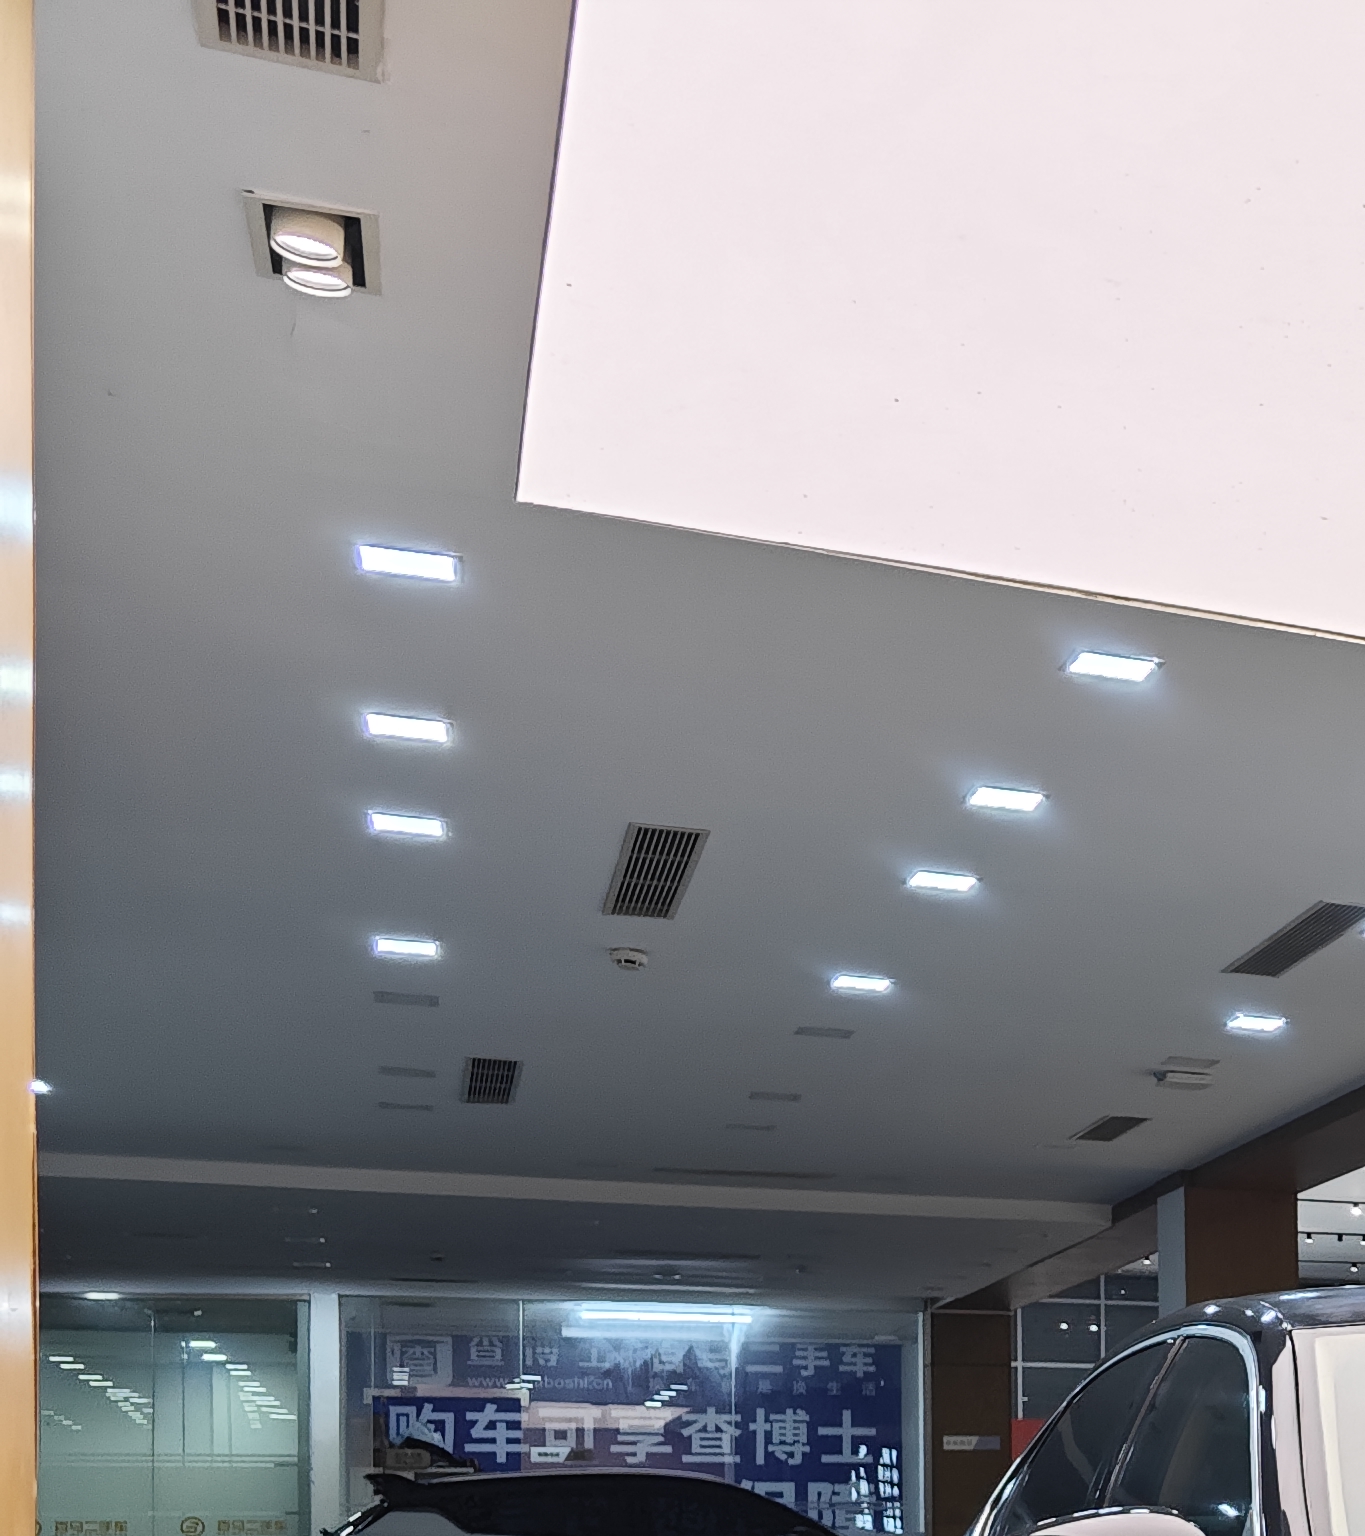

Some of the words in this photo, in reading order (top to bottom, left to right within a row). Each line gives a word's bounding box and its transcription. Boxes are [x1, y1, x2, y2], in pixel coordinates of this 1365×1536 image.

[388, 1403, 877, 1466] 购车可享查博士
